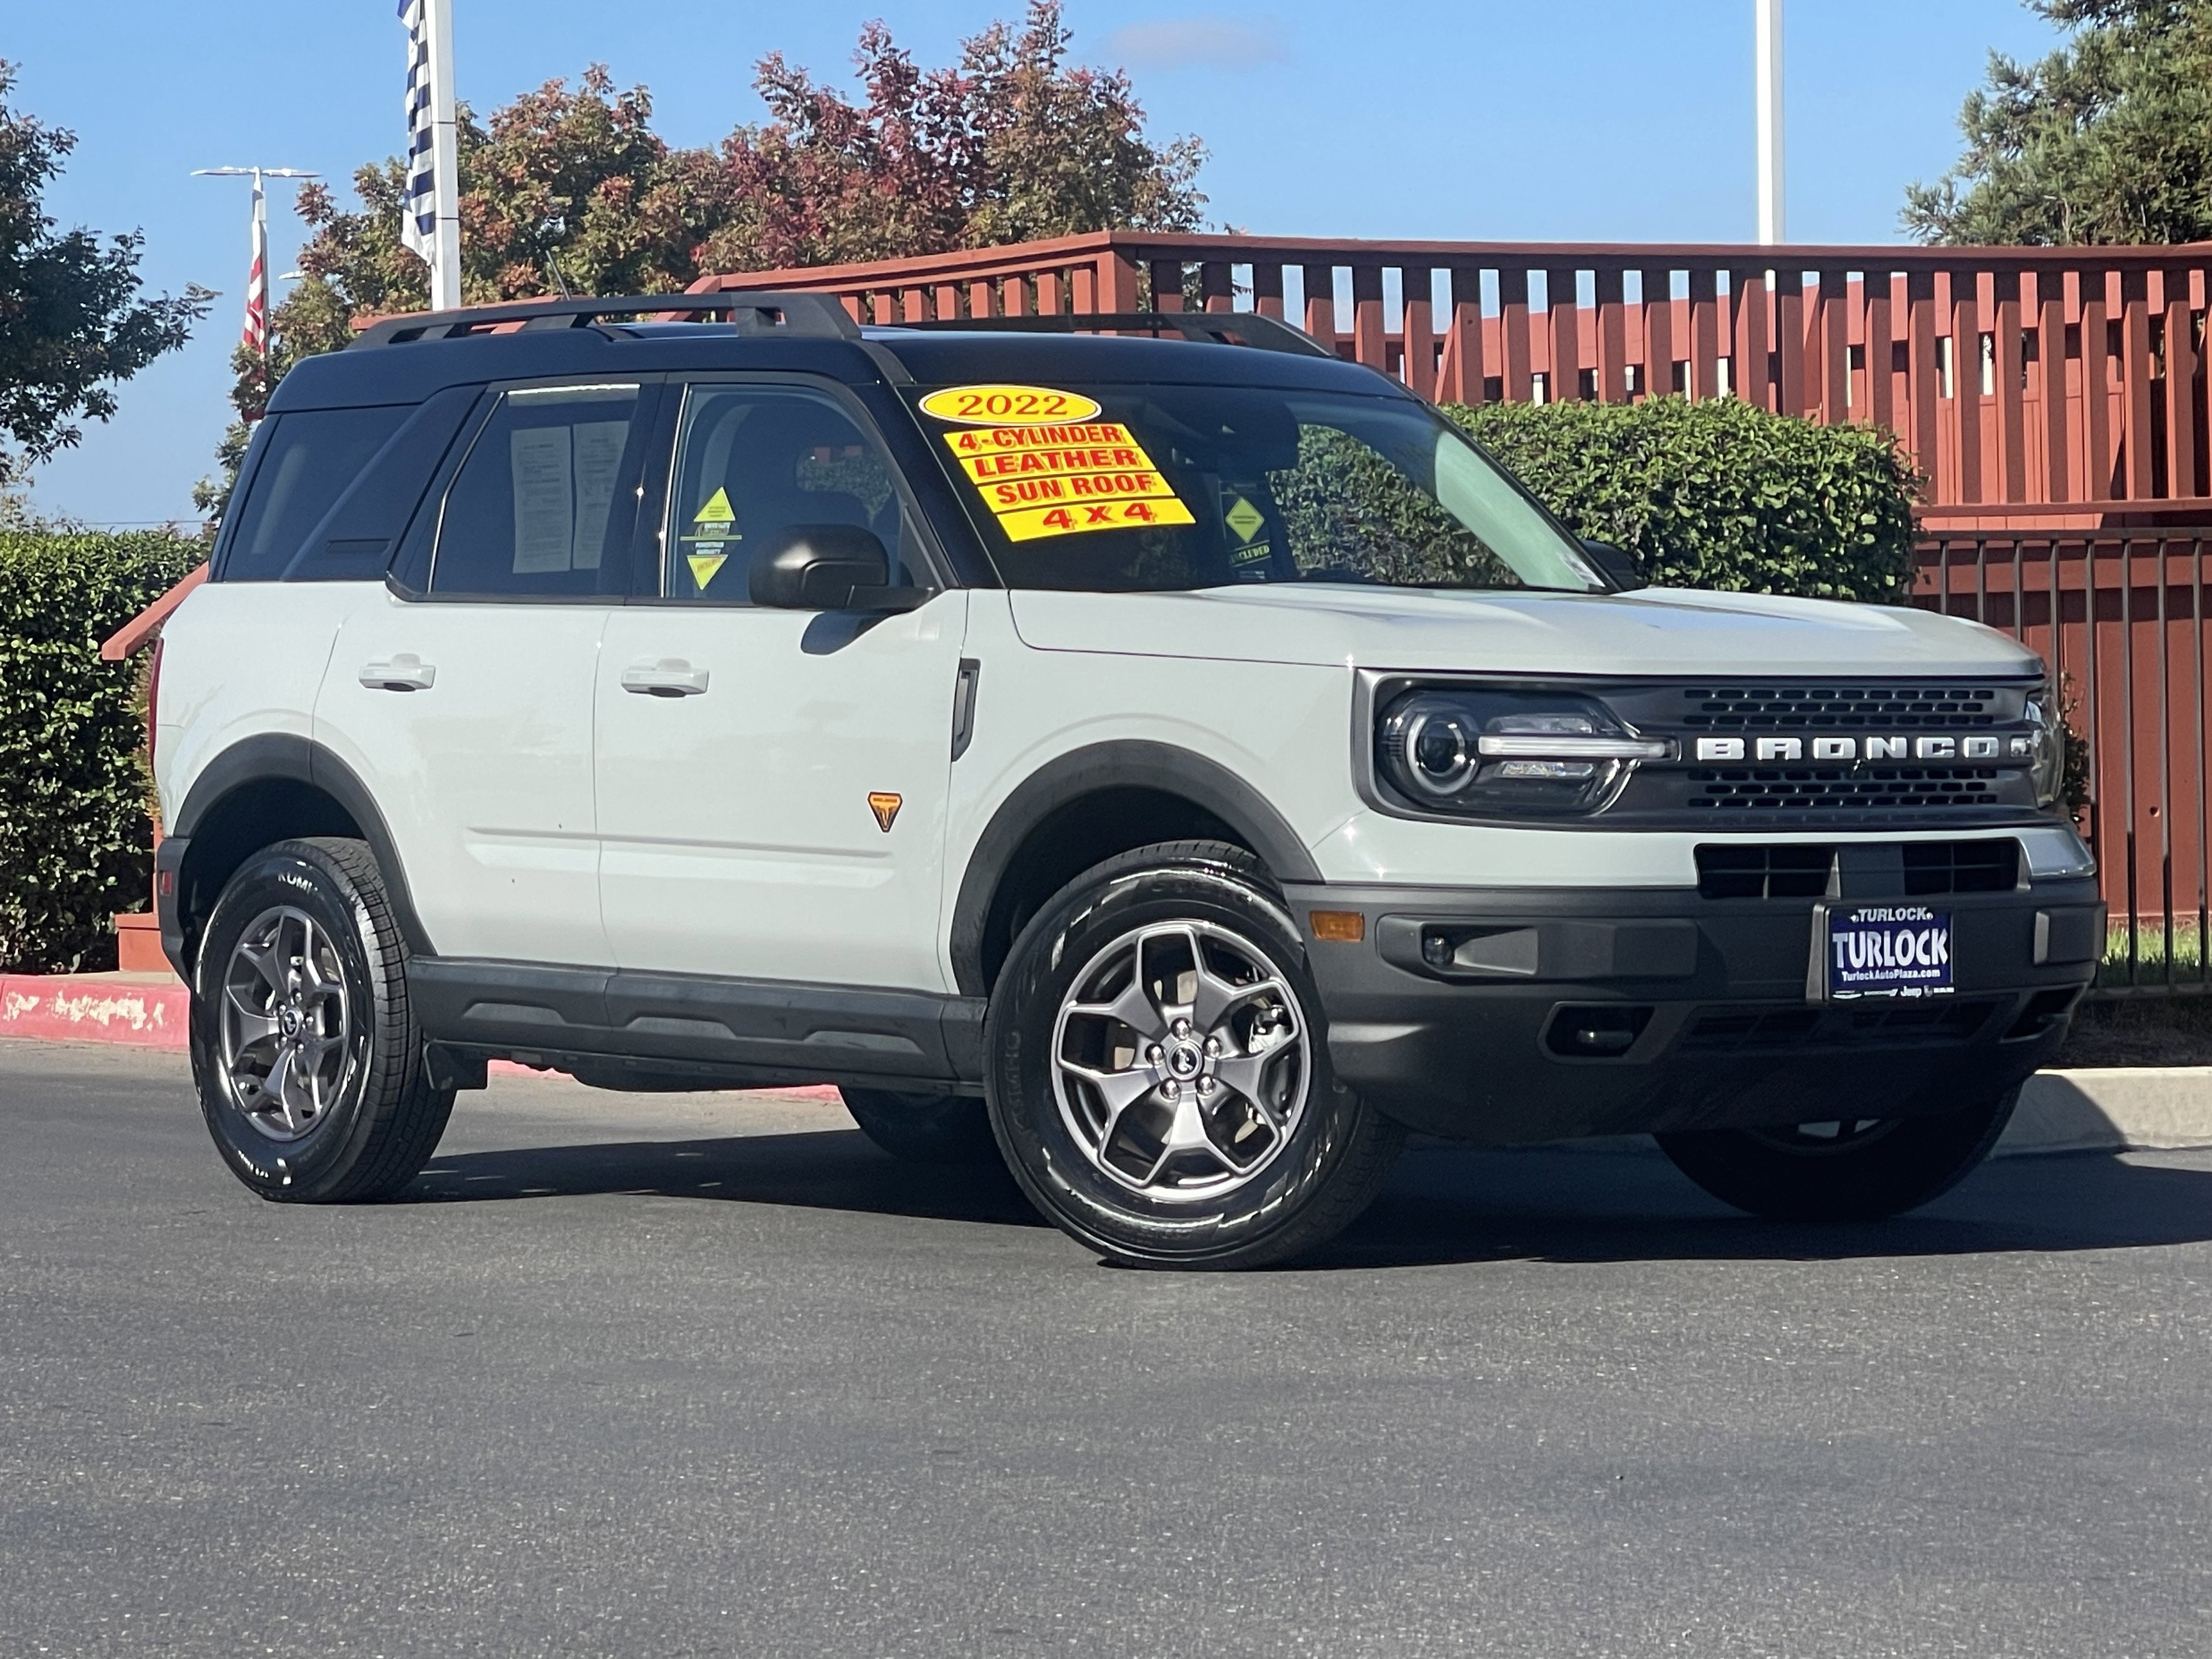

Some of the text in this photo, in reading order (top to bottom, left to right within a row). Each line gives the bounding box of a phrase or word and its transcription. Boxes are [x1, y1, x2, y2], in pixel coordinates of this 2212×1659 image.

[958, 394, 1068, 416] 2022
[958, 425, 1123, 451] 4-CYLINDER
[975, 449, 1141, 478] LEATHER
[996, 473, 1156, 505] SUN ROOF
[1697, 737, 2000, 760] BRONCO
[1858, 907, 1928, 922] TURLOCK
[1832, 928, 1948, 969] TURLOCK
[1841, 968, 1941, 981] TurlockAutoPlaza.com
